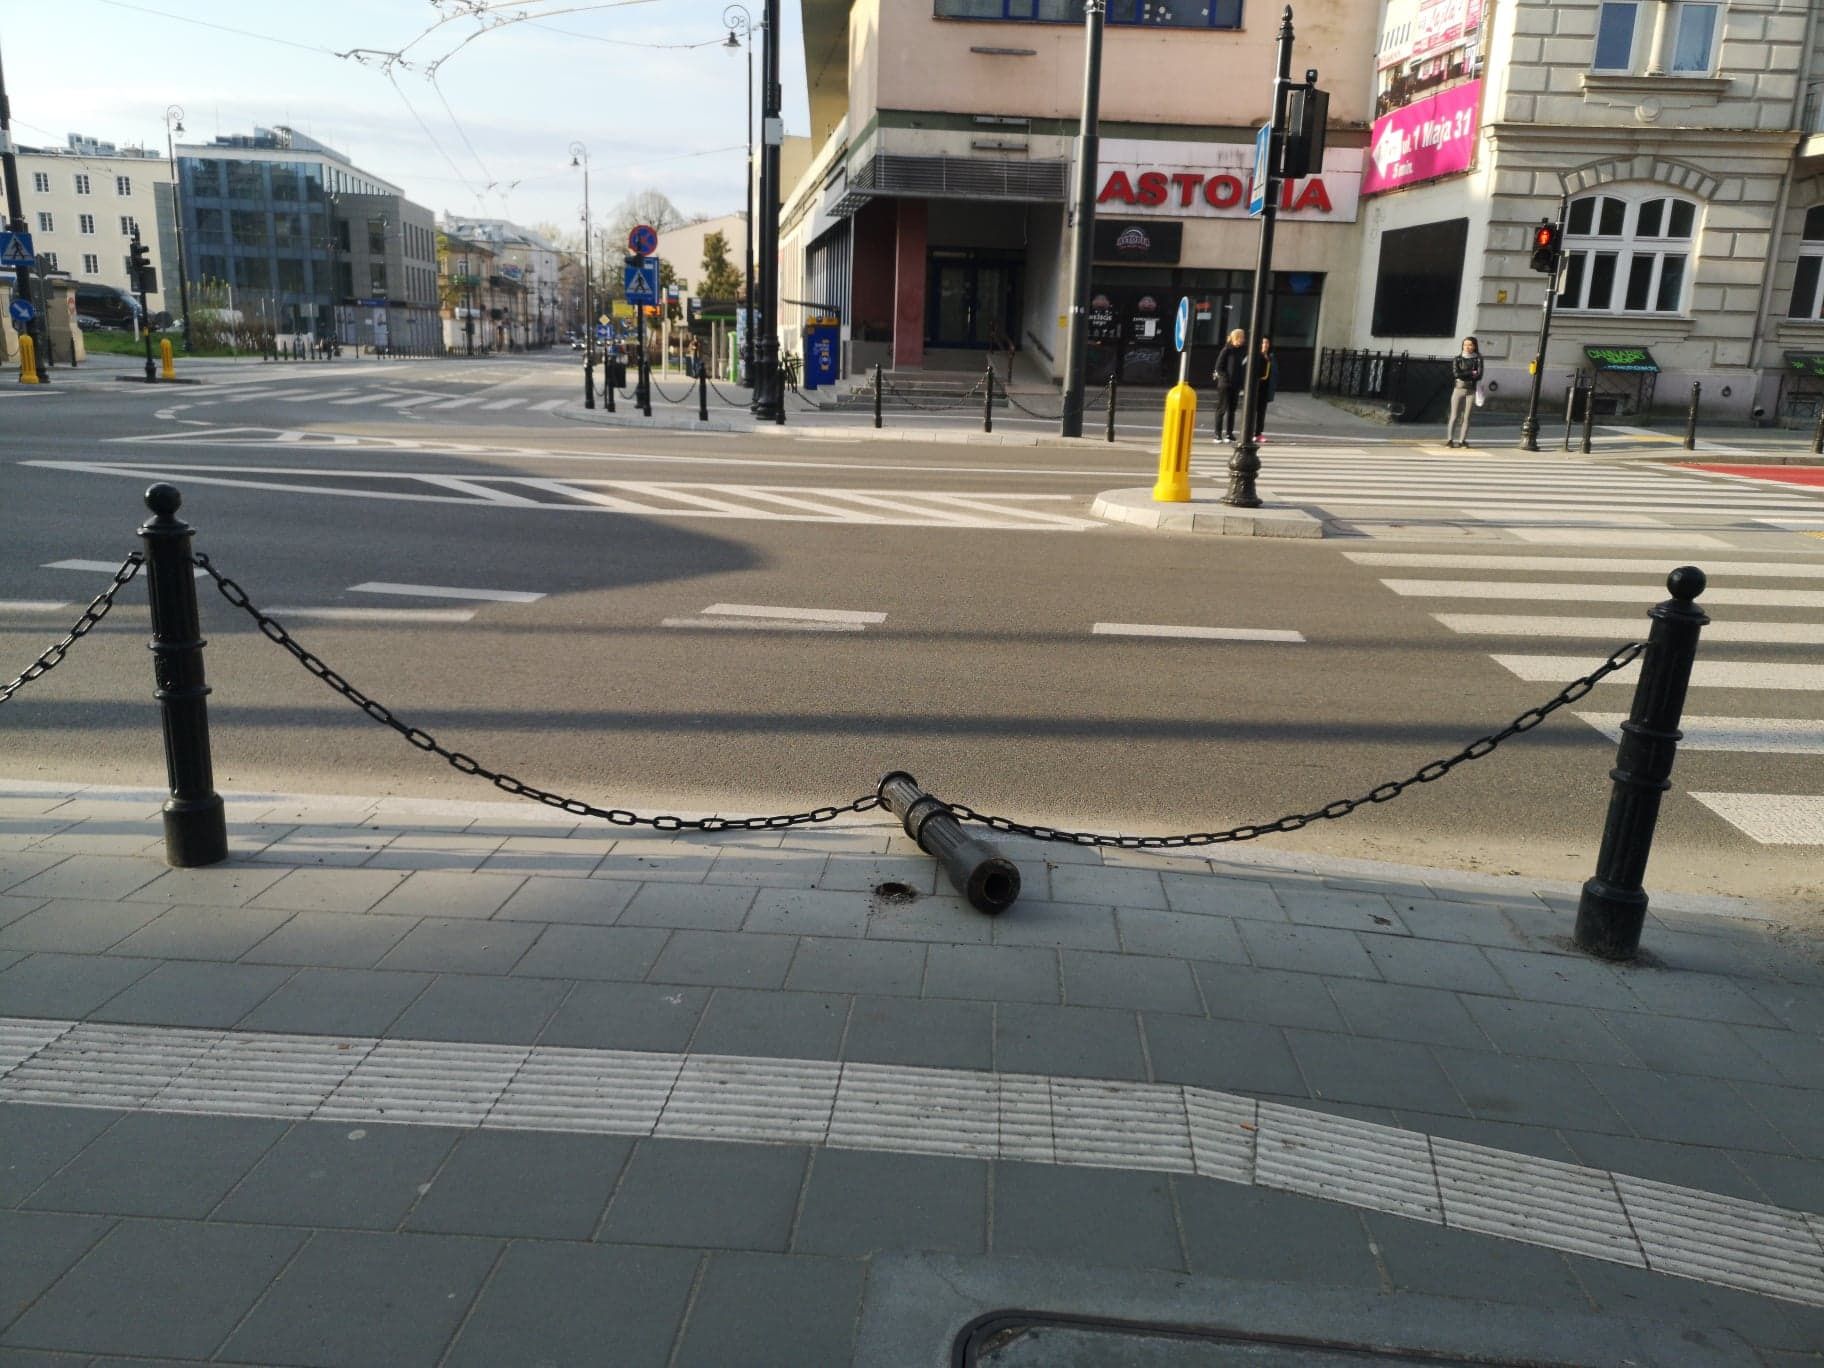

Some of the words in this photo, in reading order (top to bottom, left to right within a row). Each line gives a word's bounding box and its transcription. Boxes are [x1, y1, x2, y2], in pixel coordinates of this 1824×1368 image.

[1422, 117, 1453, 151] Maja
[1454, 107, 1473, 139] 31
[1097, 171, 1333, 212] ASTOIA
